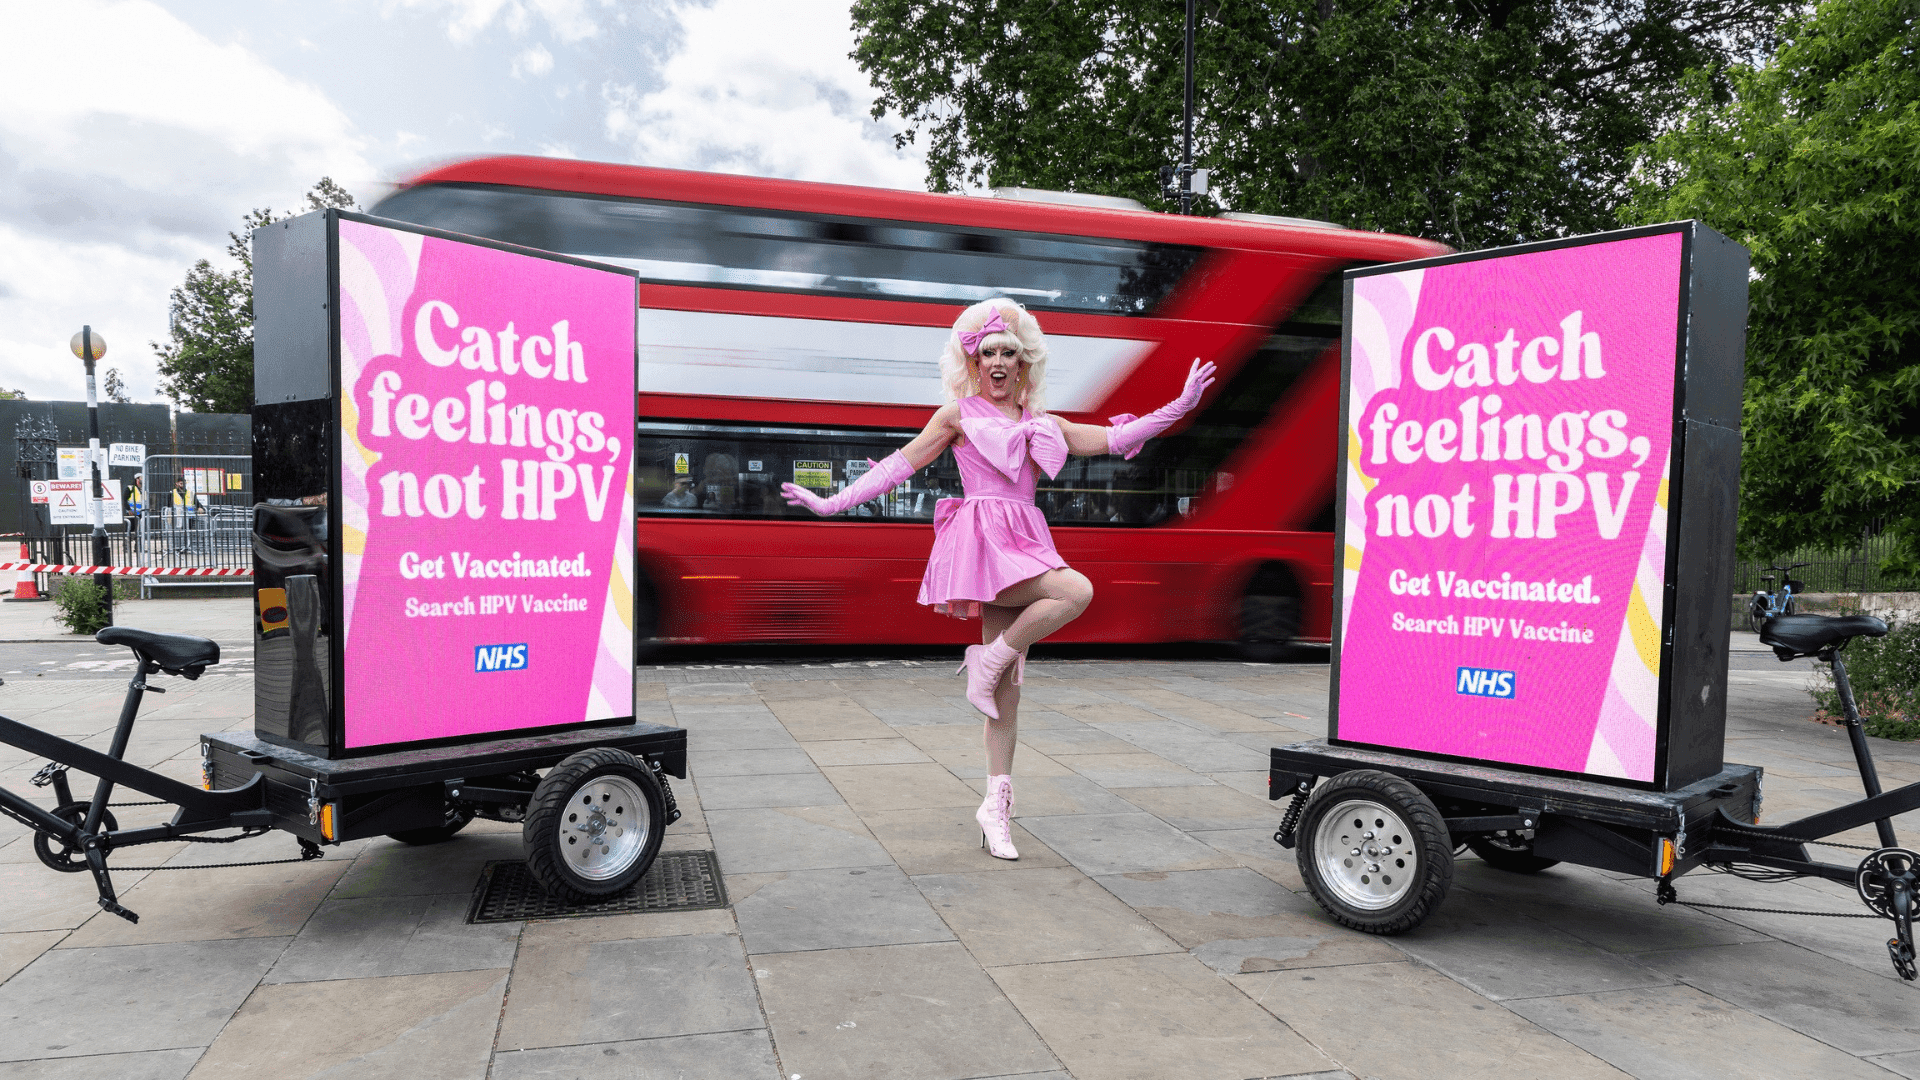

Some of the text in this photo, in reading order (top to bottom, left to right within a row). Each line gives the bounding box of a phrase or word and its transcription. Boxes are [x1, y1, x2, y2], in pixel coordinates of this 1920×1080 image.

[415, 300, 588, 383] Catch
[1412, 310, 1607, 391] Catch
[368, 371, 621, 463] feelings,
[1370, 394, 1651, 473] feelings,
[113, 453, 141, 462] PARKING
[115, 445, 139, 453] NO BIKE
[796, 461, 830, 469] CAUTION
[379, 459, 616, 522] not HPV
[1376, 471, 1641, 540] not HPV
[399, 551, 592, 579] Get Vaccinated.
[1389, 569, 1601, 605] Get Vaccinated.
[405, 593, 588, 618] Search HPV Vaccine
[1391, 611, 1595, 645] Search HPV Vaccine
[476, 644, 526, 671] NHS
[1457, 668, 1514, 697] NHS
